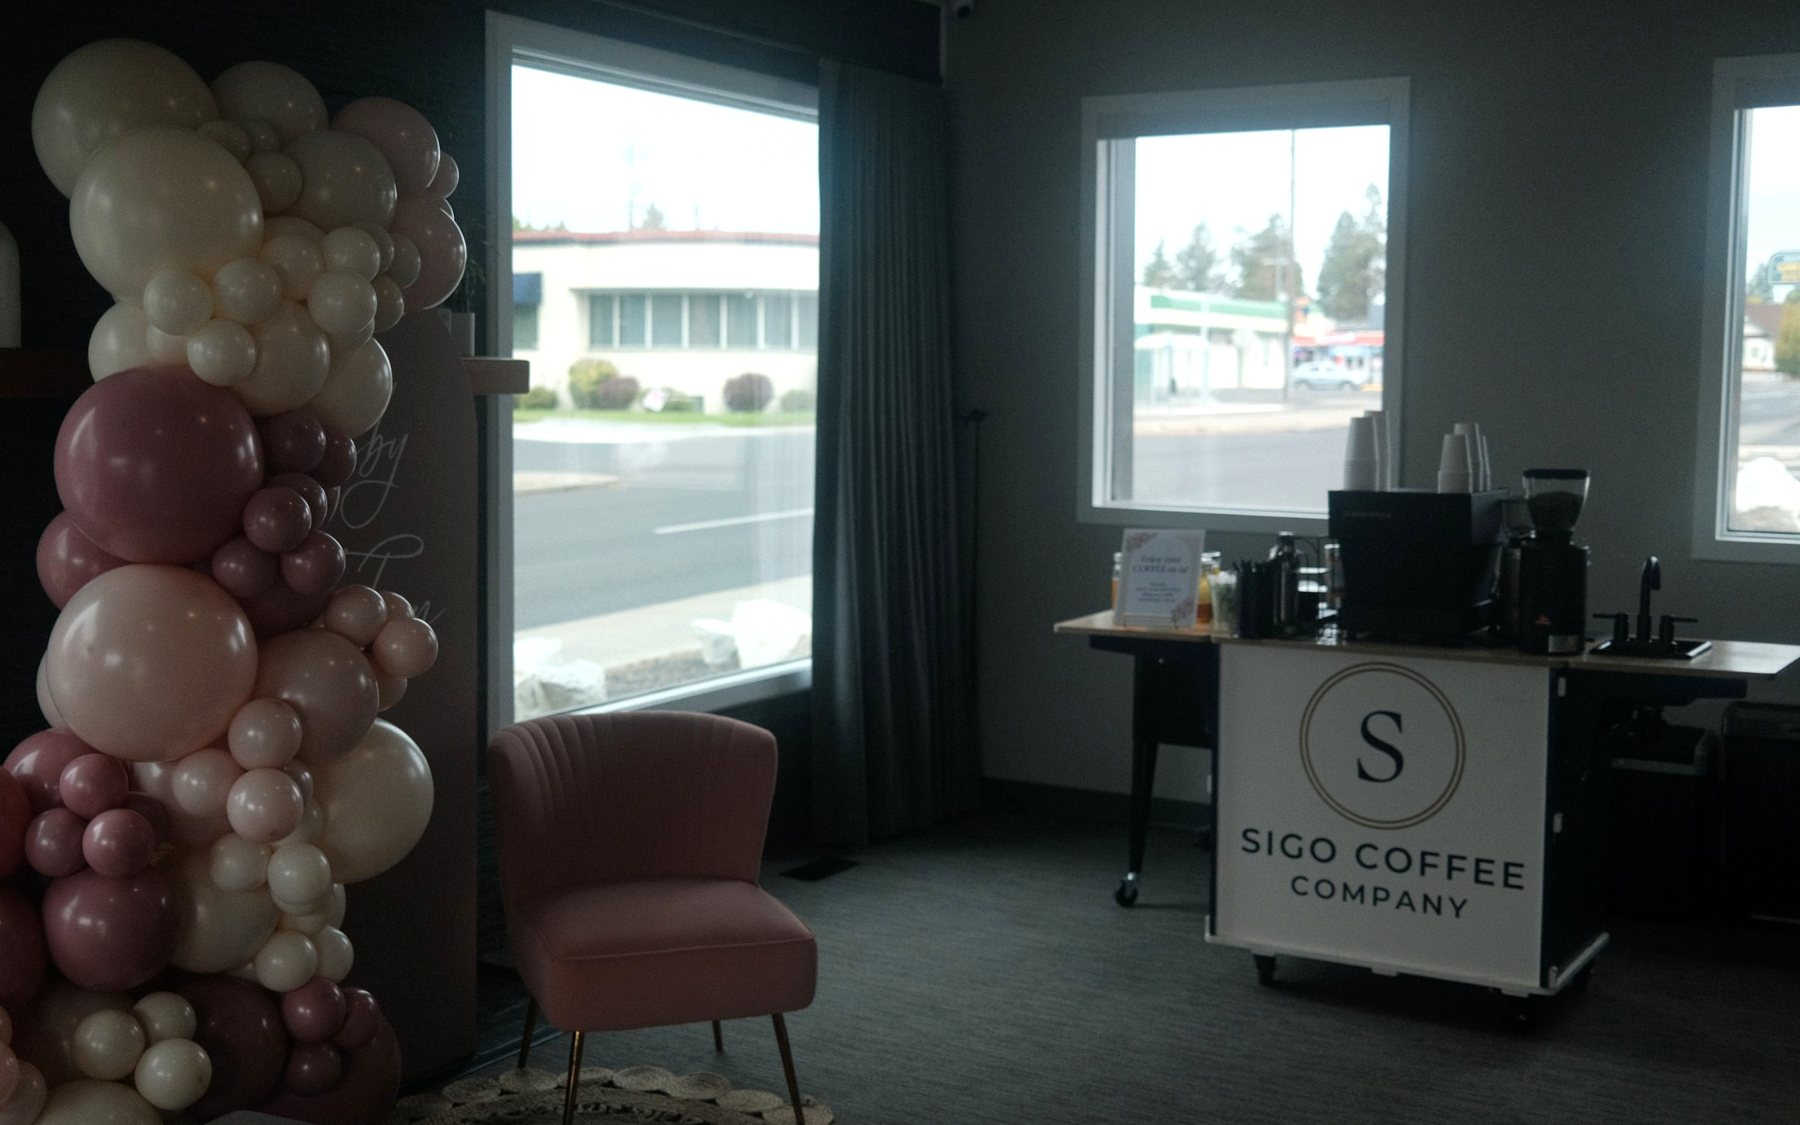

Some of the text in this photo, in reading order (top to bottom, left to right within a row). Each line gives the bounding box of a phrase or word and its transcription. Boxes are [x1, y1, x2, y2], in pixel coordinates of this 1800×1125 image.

[1356, 709, 1405, 784] S
[1241, 827, 1525, 890] SIGO COFFEE
[1290, 875, 1468, 919] COMPANY
